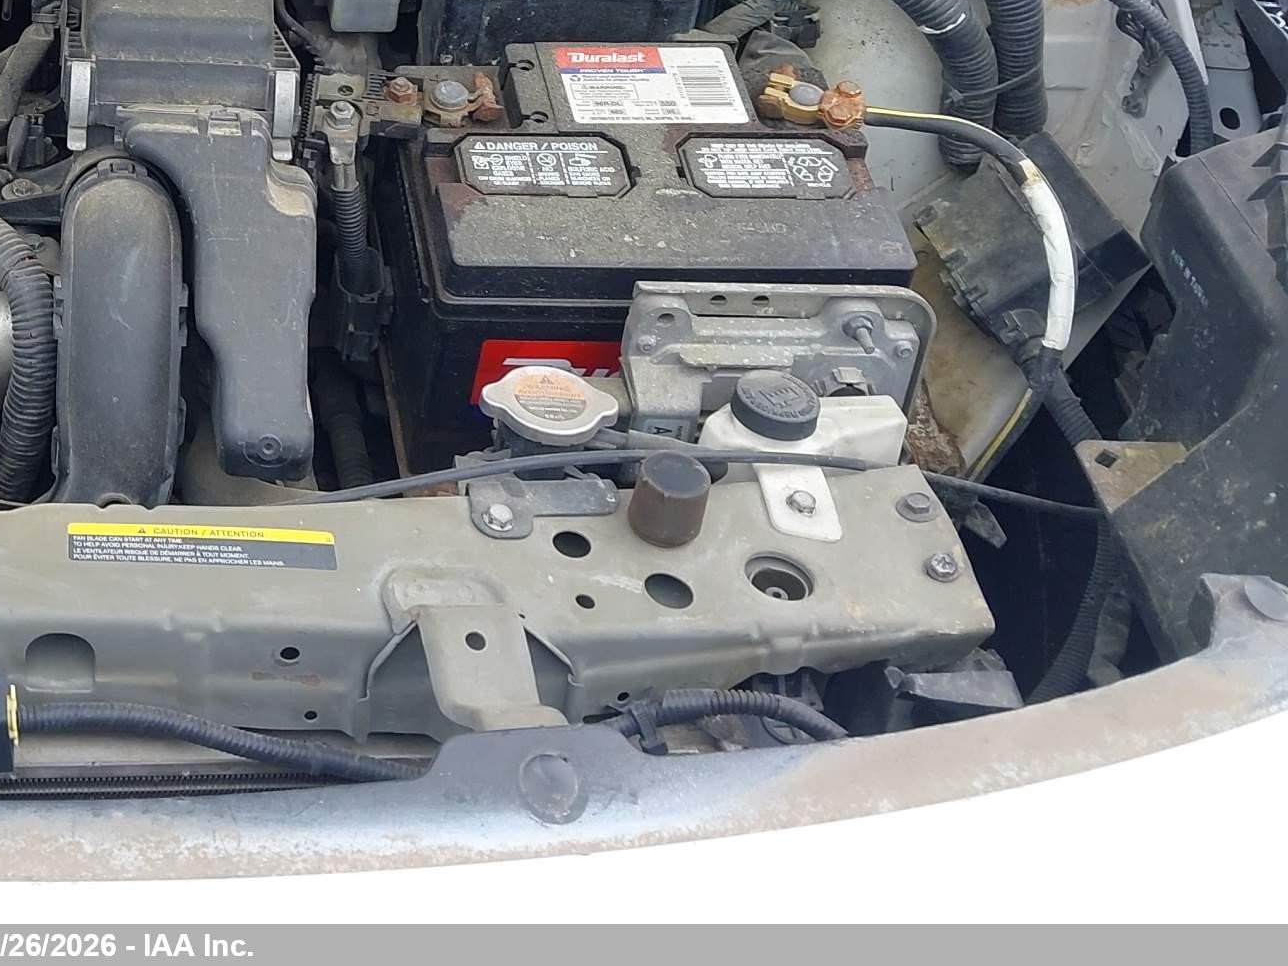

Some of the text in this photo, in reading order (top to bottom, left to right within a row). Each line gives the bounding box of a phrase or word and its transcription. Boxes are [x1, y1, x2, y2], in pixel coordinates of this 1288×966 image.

[566, 52, 646, 63] Duralast
[485, 142, 598, 151] DANGER / POISON
[153, 528, 198, 536] CAUTION
[209, 530, 265, 538] ATTENTION
[121, 542, 156, 550] PERSONAL
